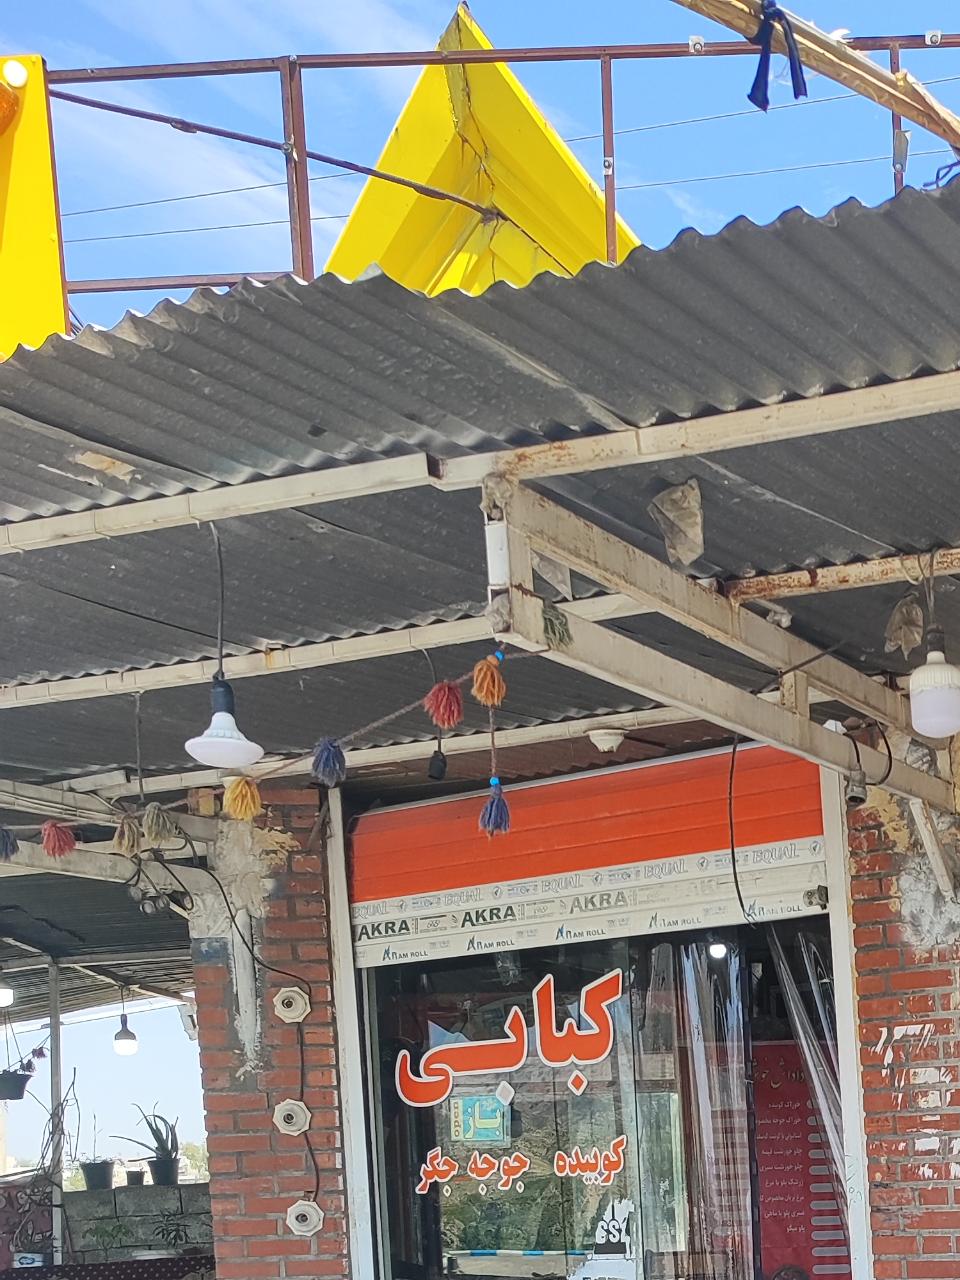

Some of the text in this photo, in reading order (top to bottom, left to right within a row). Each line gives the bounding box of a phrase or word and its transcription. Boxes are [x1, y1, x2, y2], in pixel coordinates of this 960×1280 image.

[569, 890, 629, 915] AKRA
[460, 905, 518, 929] AKRA
[357, 918, 411, 942] AKRA
[586, 928, 607, 938] ROLL
[410, 950, 429, 959] ROLL
[496, 939, 515, 948] ROLL
[395, 968, 623, 1107] کبابی
[453, 1101, 461, 1137] open
[464, 1101, 501, 1139] باز
[415, 1134, 628, 1197] کوبیده جوجه جگر
